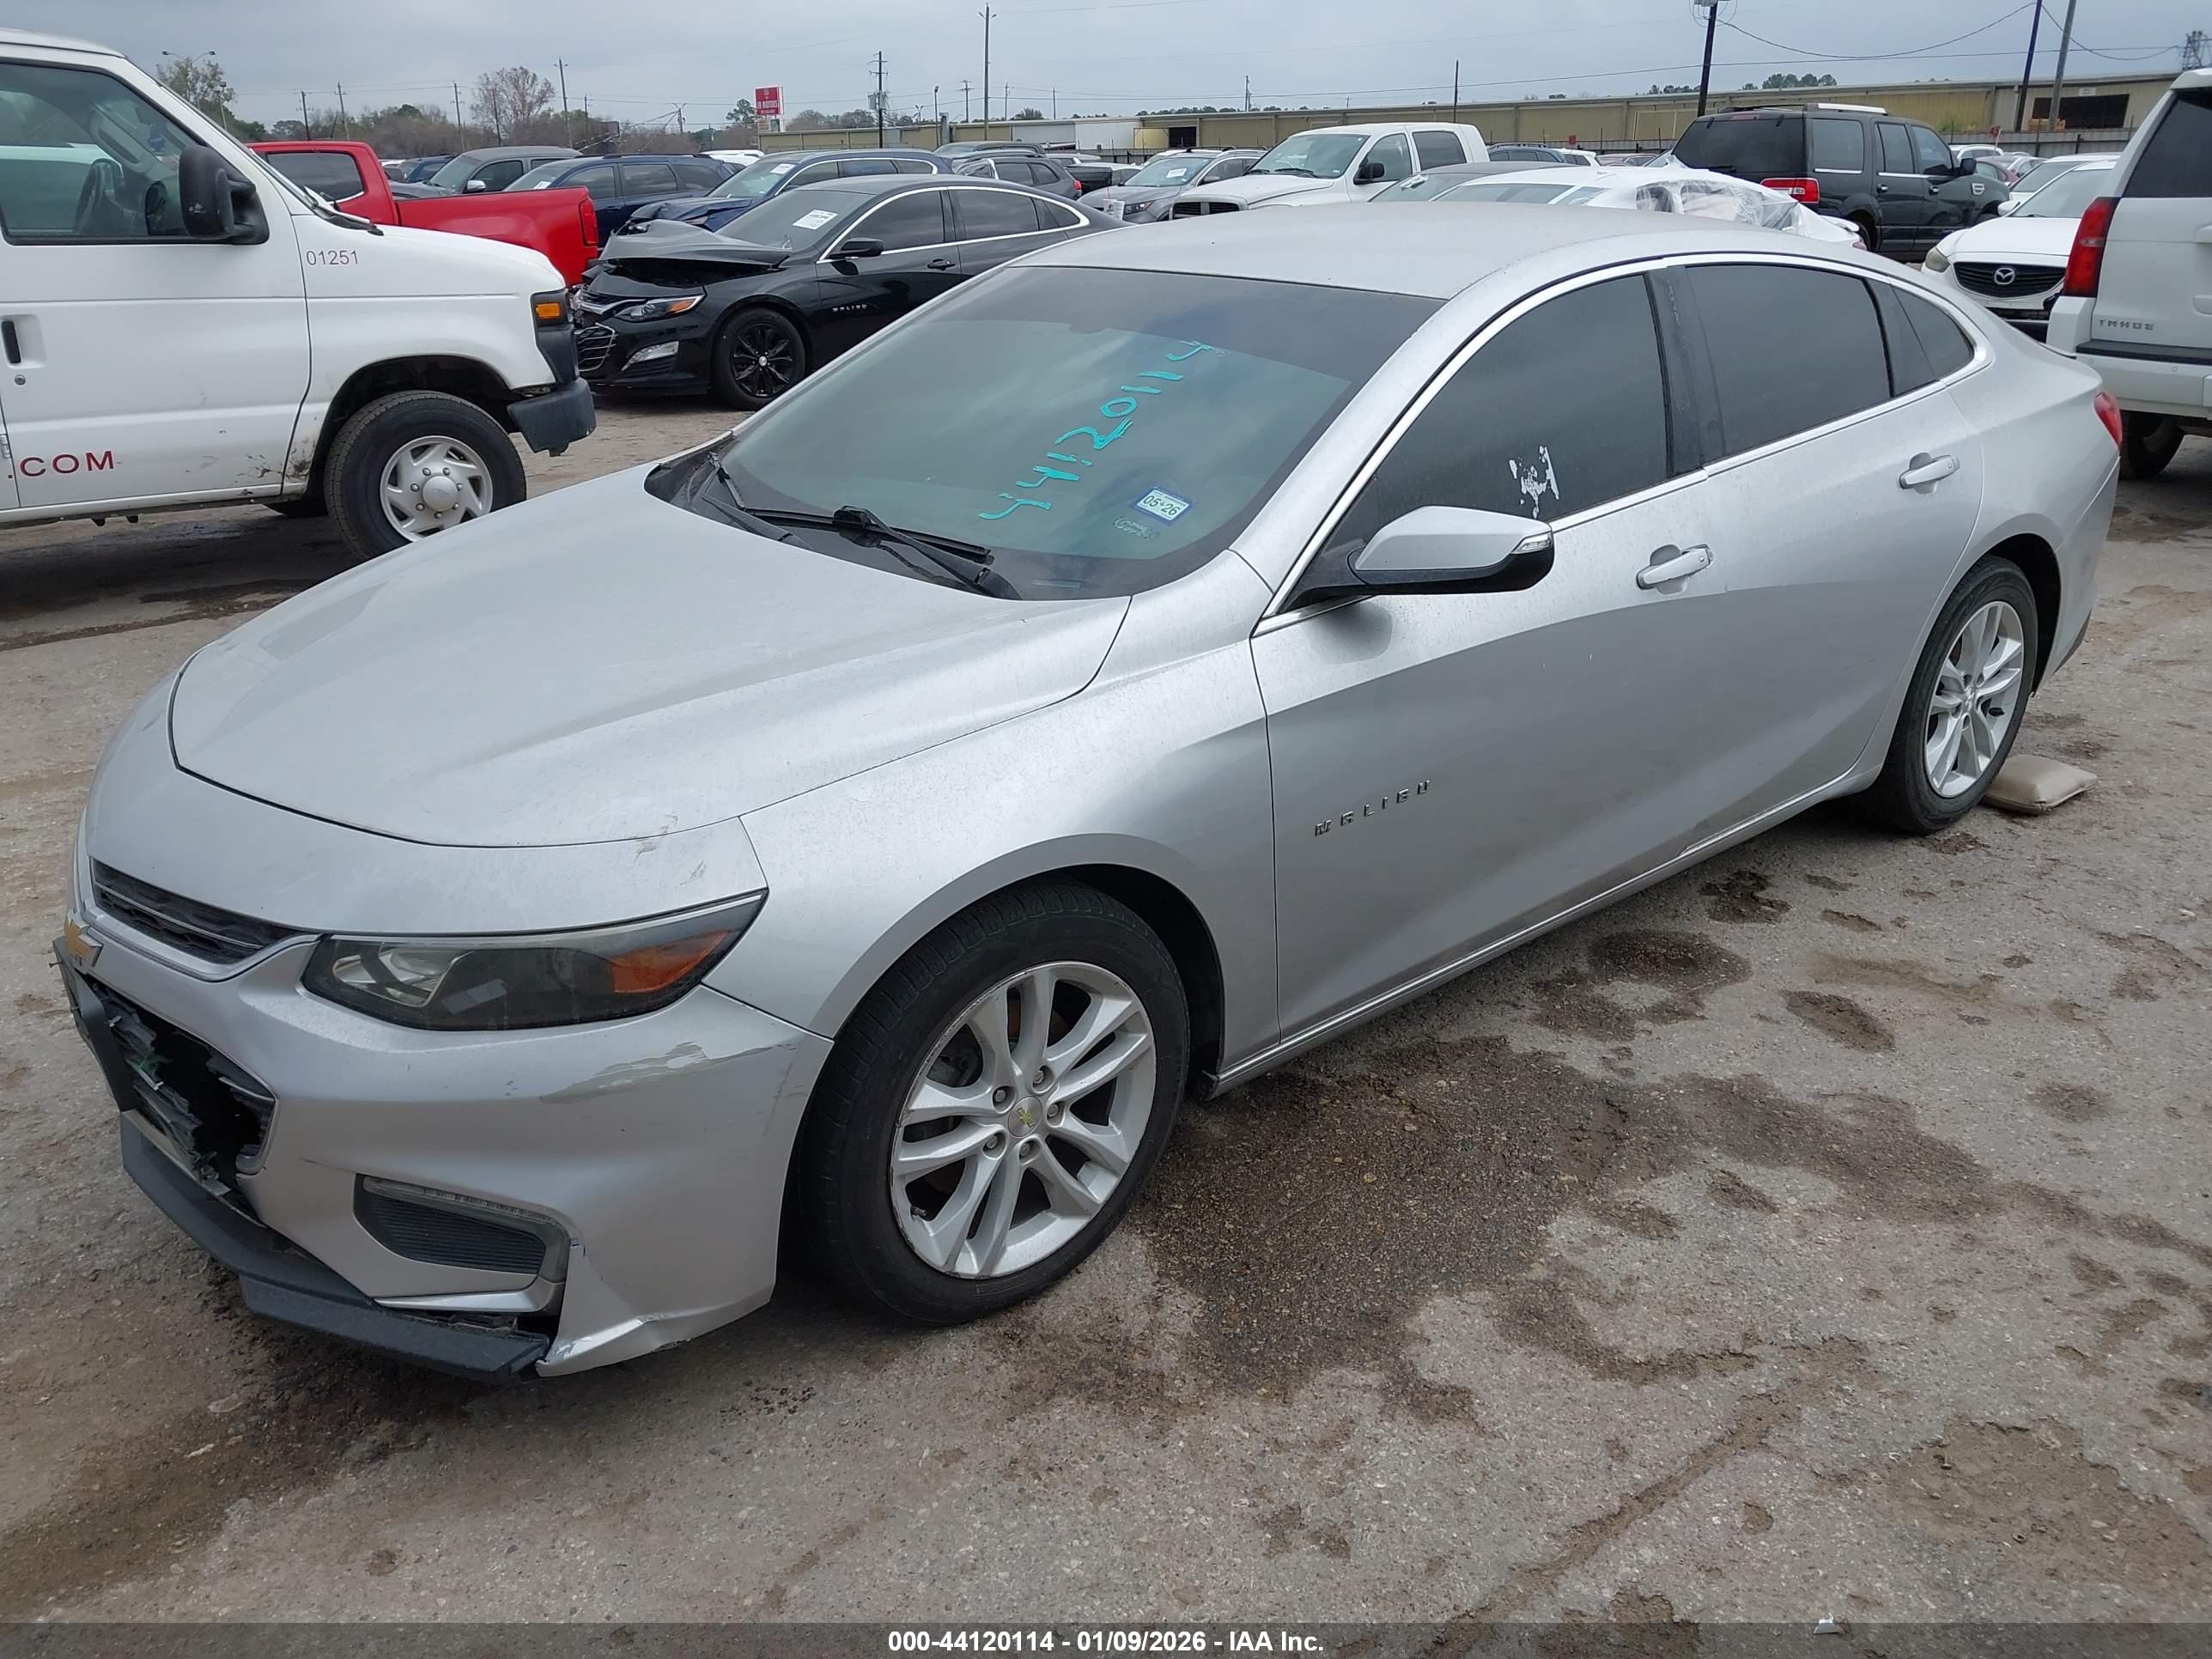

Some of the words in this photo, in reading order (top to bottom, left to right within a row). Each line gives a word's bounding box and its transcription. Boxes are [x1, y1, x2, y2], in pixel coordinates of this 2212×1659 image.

[306, 250, 358, 265] 01251
[2099, 319, 2154, 330] TAHOE
[1315, 779, 1431, 837] MALIBU
